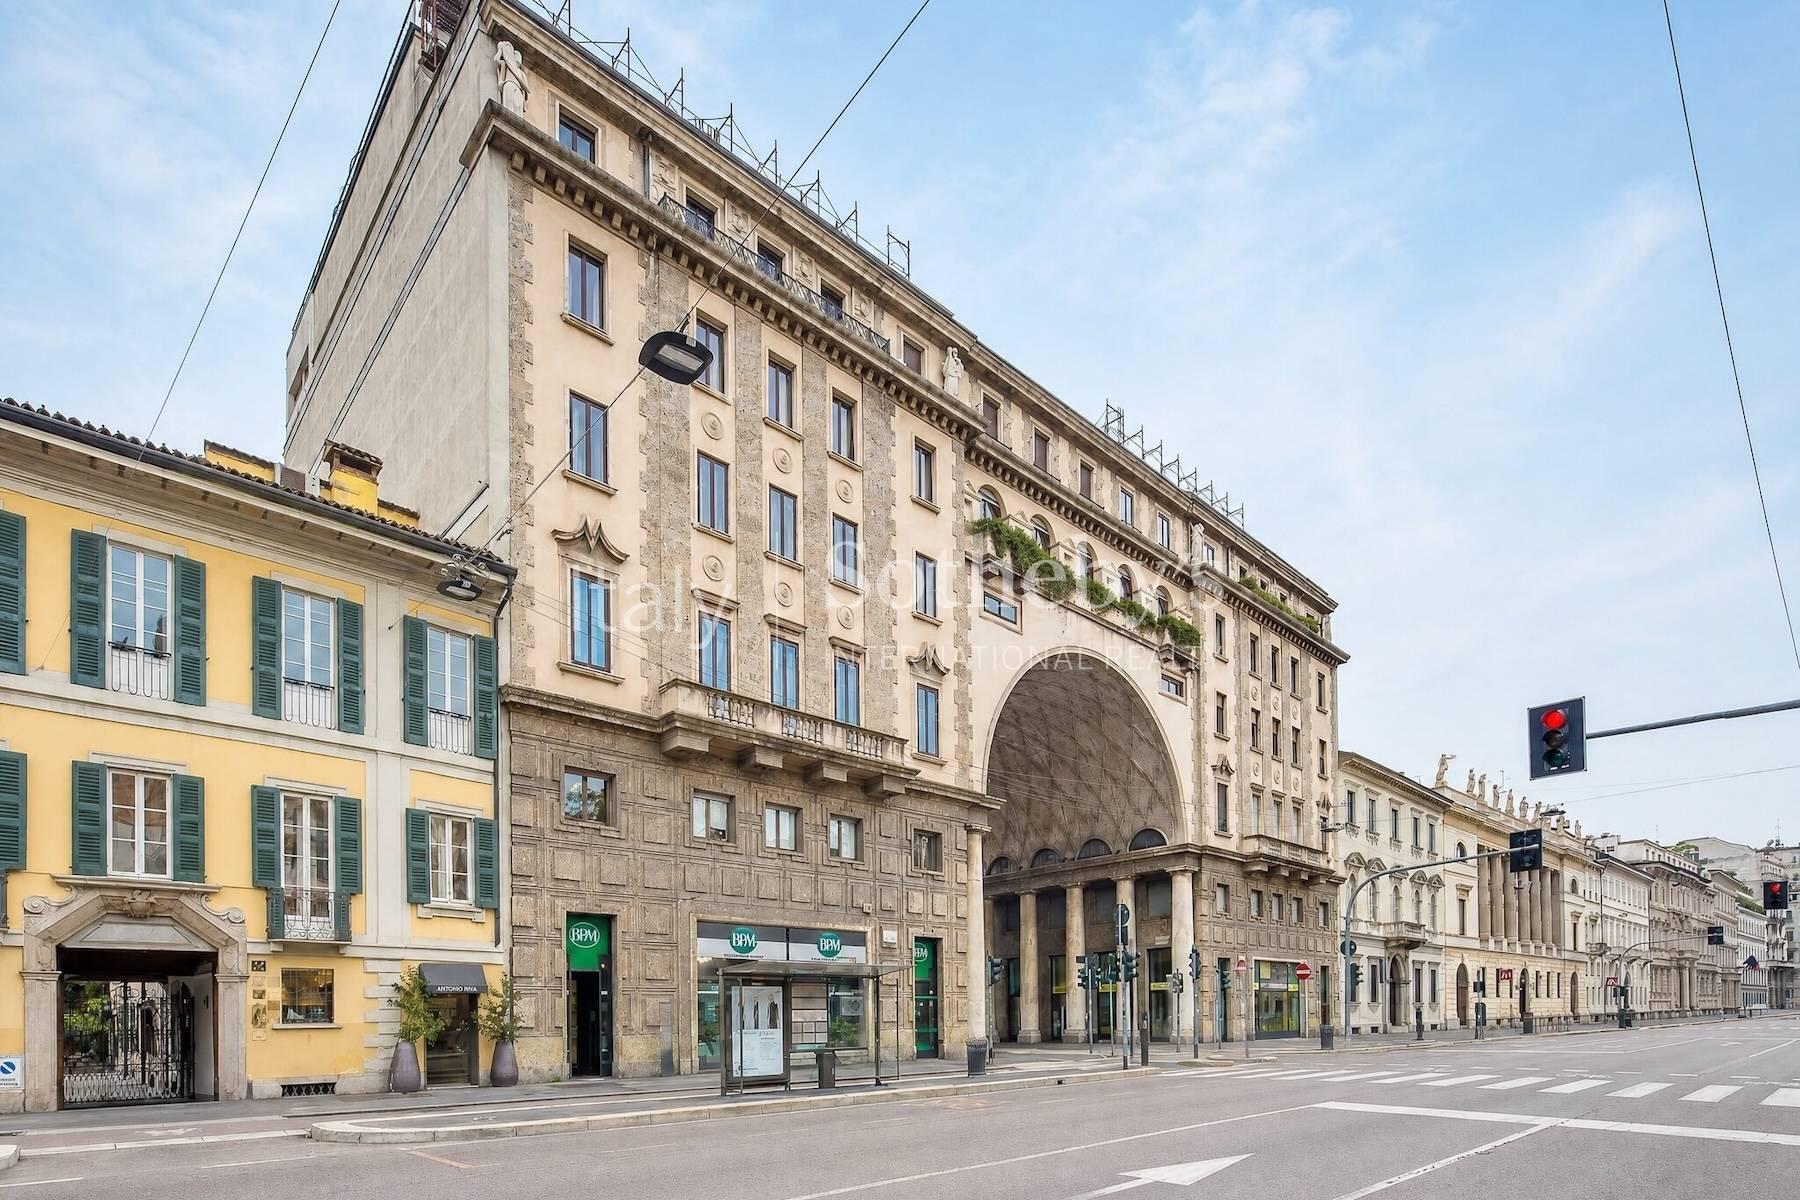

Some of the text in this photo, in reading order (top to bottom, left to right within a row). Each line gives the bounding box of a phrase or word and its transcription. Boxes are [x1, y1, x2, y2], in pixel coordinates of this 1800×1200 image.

[571, 927, 598, 942] BPM
[732, 932, 756, 948] BPM
[820, 937, 841, 952] BPM
